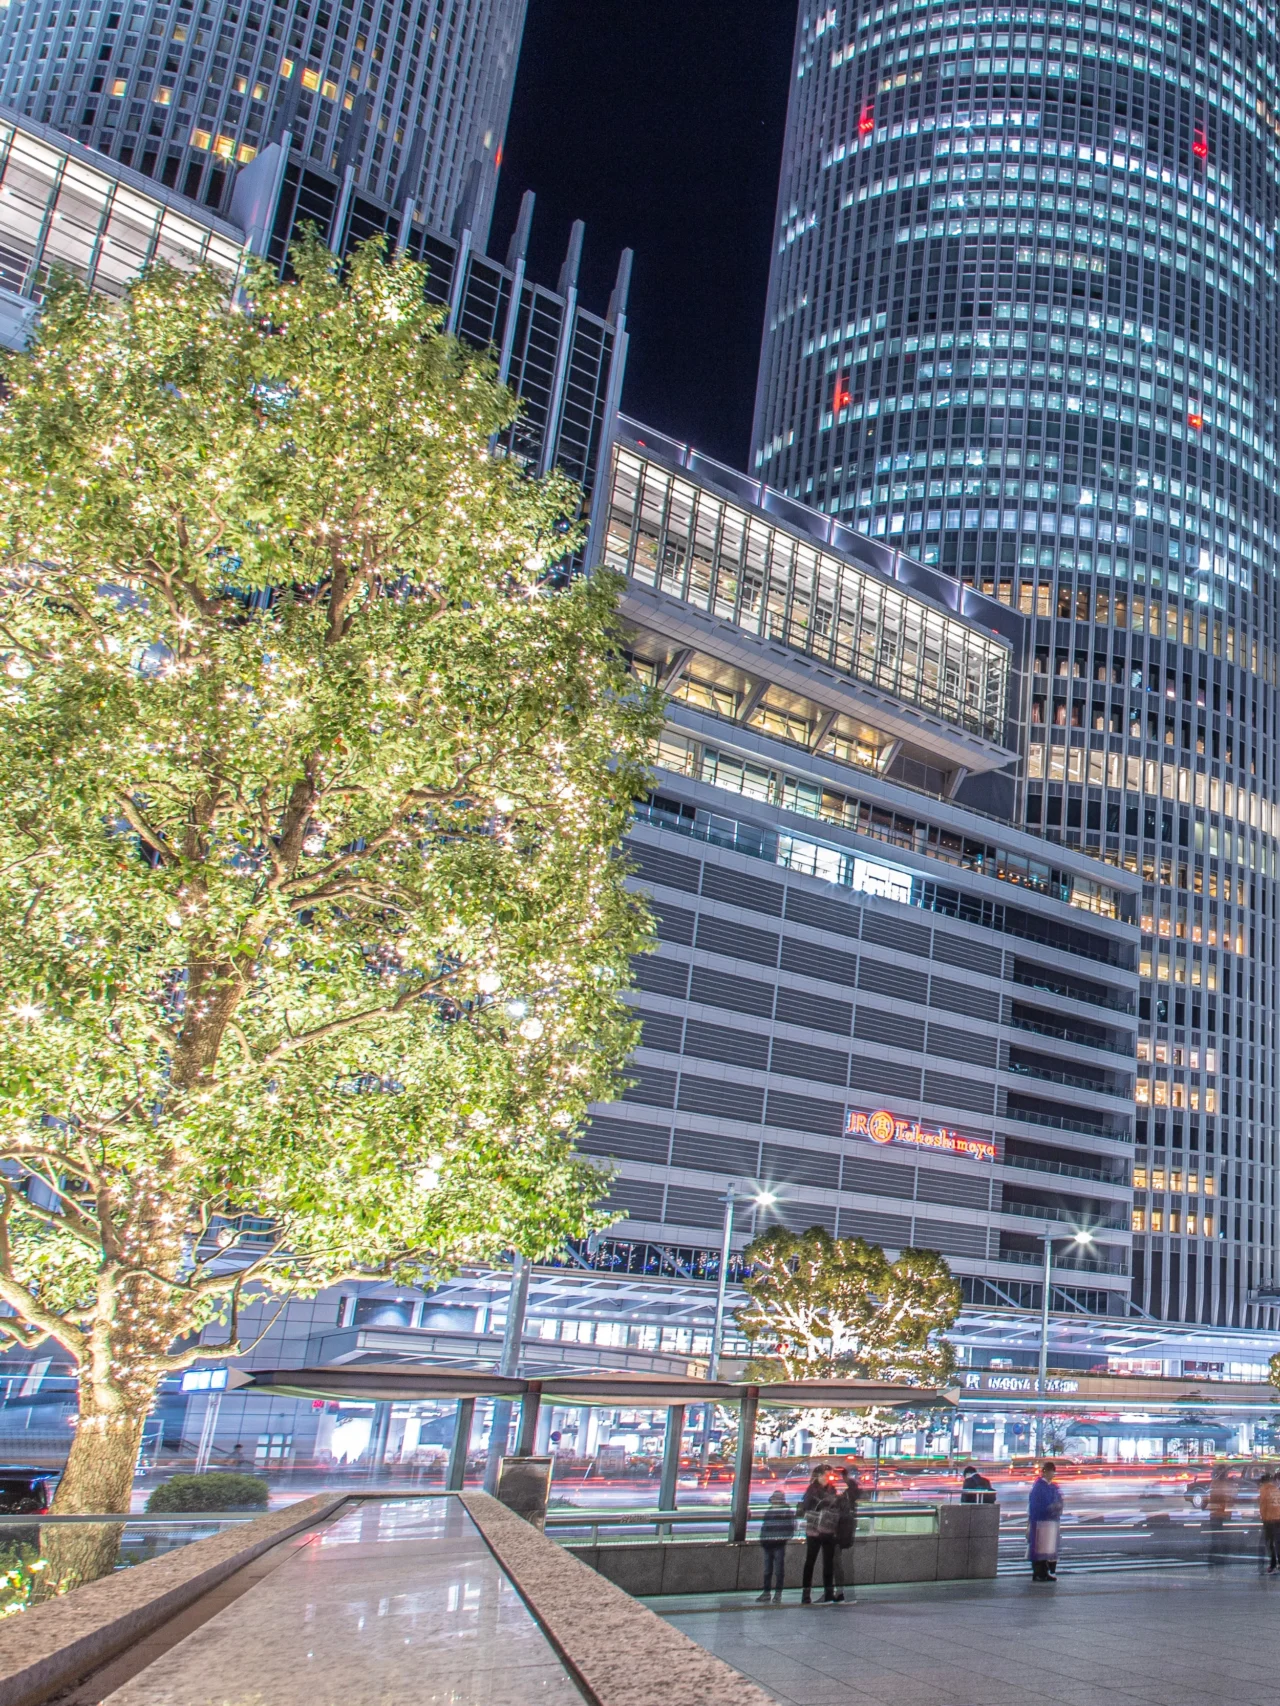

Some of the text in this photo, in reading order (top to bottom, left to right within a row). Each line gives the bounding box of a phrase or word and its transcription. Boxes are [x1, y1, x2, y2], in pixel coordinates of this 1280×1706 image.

[848, 1111, 869, 1134] JR
[895, 1120, 996, 1160] Takashimaya
[1034, 1379, 1080, 1393] SATION
